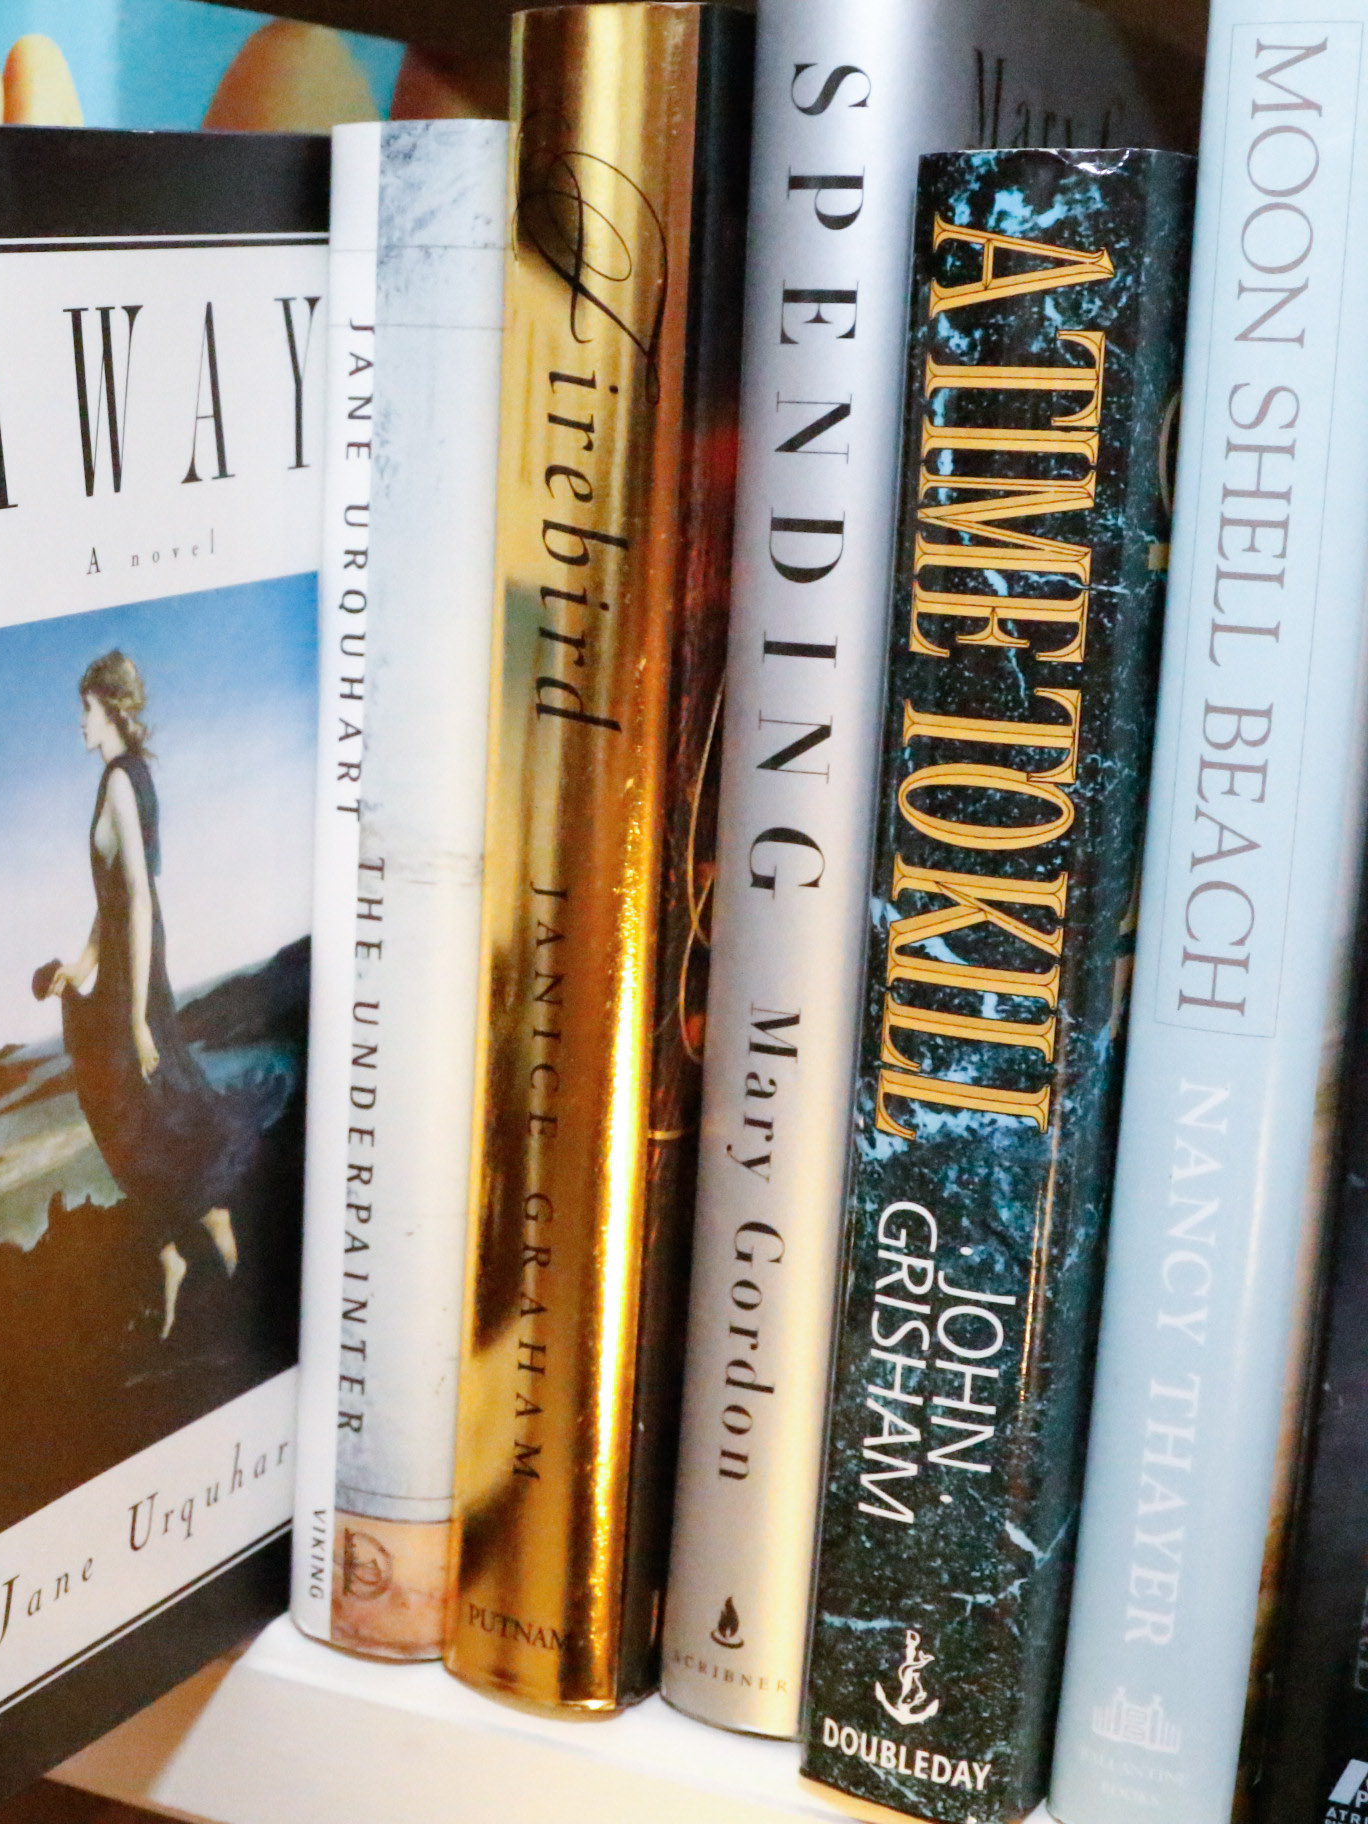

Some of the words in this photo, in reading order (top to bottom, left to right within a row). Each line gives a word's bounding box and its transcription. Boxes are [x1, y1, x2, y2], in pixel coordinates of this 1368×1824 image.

[927, 212, 1116, 319] A
[1233, 36, 1329, 350] MOON
[345, 317, 376, 464] JANE
[747, 61, 872, 899] SPENDING
[907, 328, 1107, 664] TIME
[86, 546, 102, 576] A
[131, 528, 217, 568] novel
[1207, 380, 1302, 669] SHELL
[336, 503, 372, 823] URQUHART
[896, 687, 1084, 851] TO
[355, 856, 386, 963] THE
[1176, 698, 1275, 1018] BEACH
[528, 882, 570, 1139] JANICE
[725, 1003, 802, 1186] Mary
[874, 853, 1070, 1141] KILL
[338, 1000, 384, 1434] UNDERPAINTER
[513, 1192, 556, 1482] GRAHAM
[1155, 1076, 1232, 1345] NANCY
[717, 1220, 786, 1483] Gordon
[857, 1199, 938, 1525] GRISHAM
[128, 1441, 291, 1553] Urquhar
[308, 1508, 329, 1602] VIKING
[1123, 1372, 1202, 1646] THAYER
[672, 1651, 789, 1693] SCRIBNER
[822, 1716, 992, 1792] DOUBLEDAY
